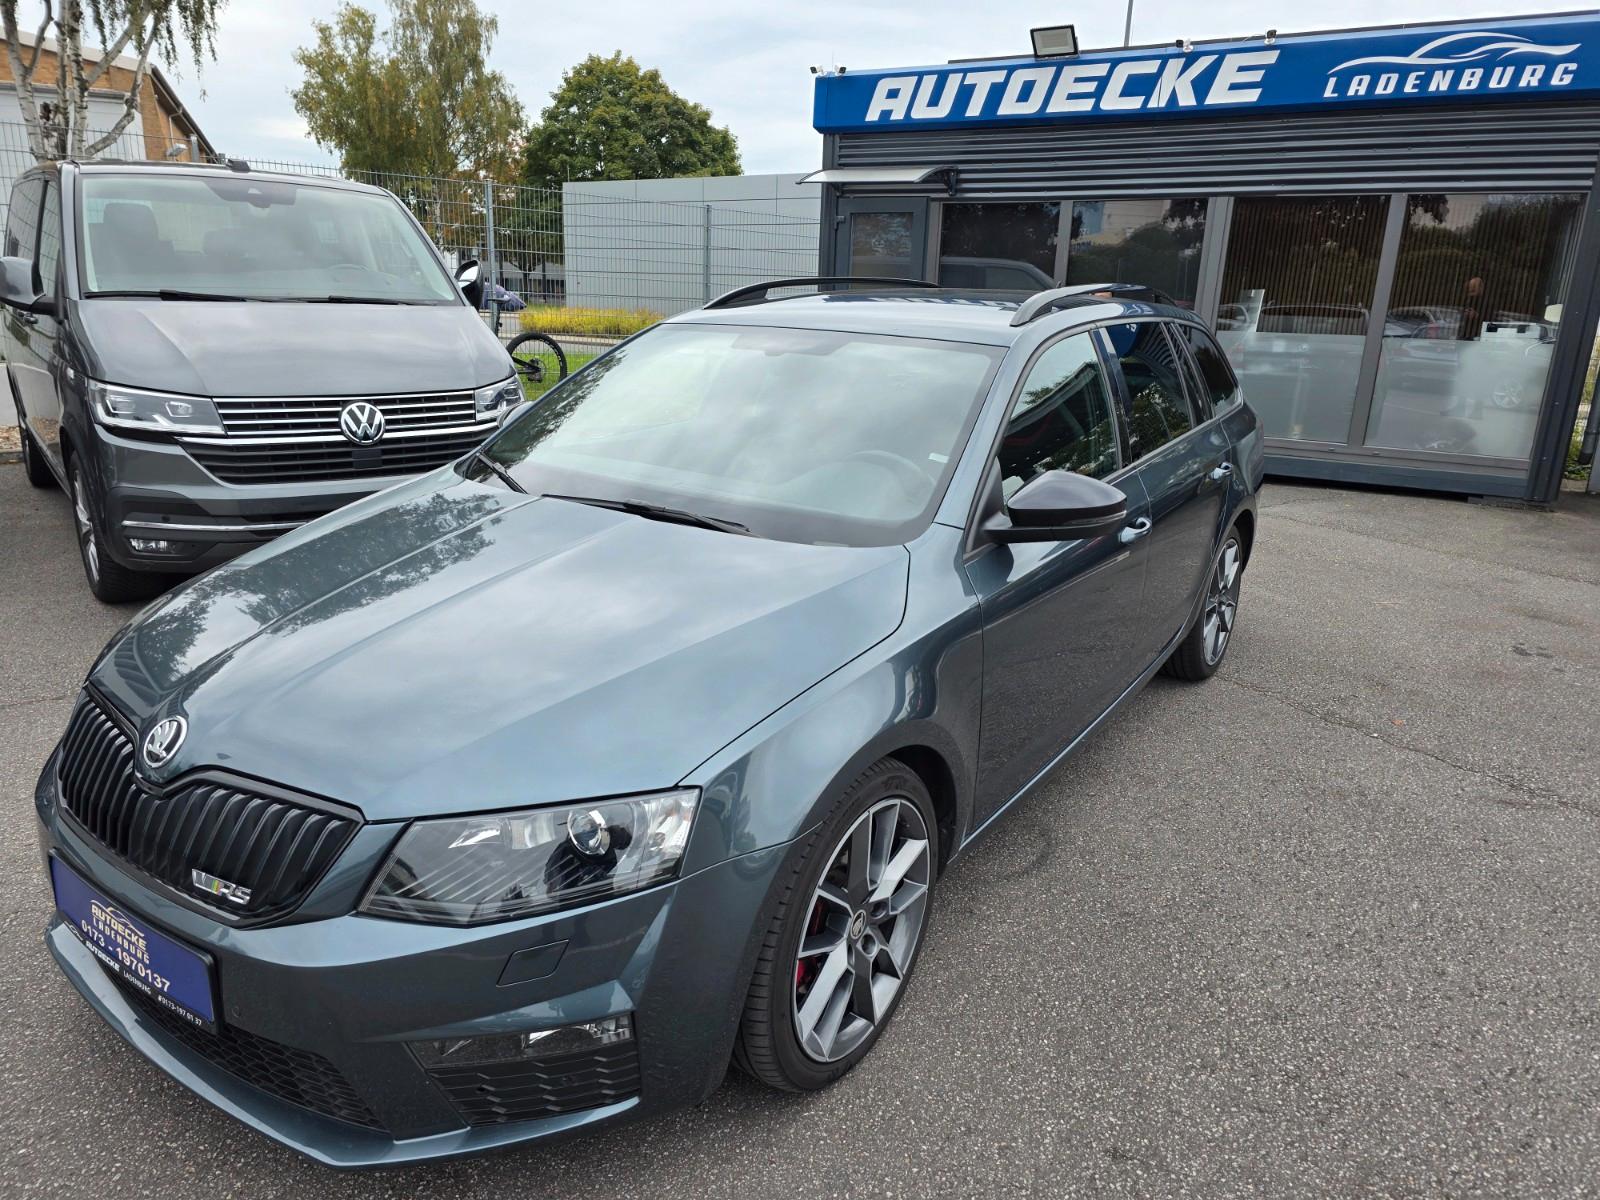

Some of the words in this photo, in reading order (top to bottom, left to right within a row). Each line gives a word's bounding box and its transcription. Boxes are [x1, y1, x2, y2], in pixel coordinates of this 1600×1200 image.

[865, 49, 1280, 122] AUTOECKE
[1323, 63, 1578, 98] LADENBURG
[81, 919, 105, 947] 0173
[116, 947, 170, 992] 1970137
[91, 904, 147, 951] AUTOECKE
